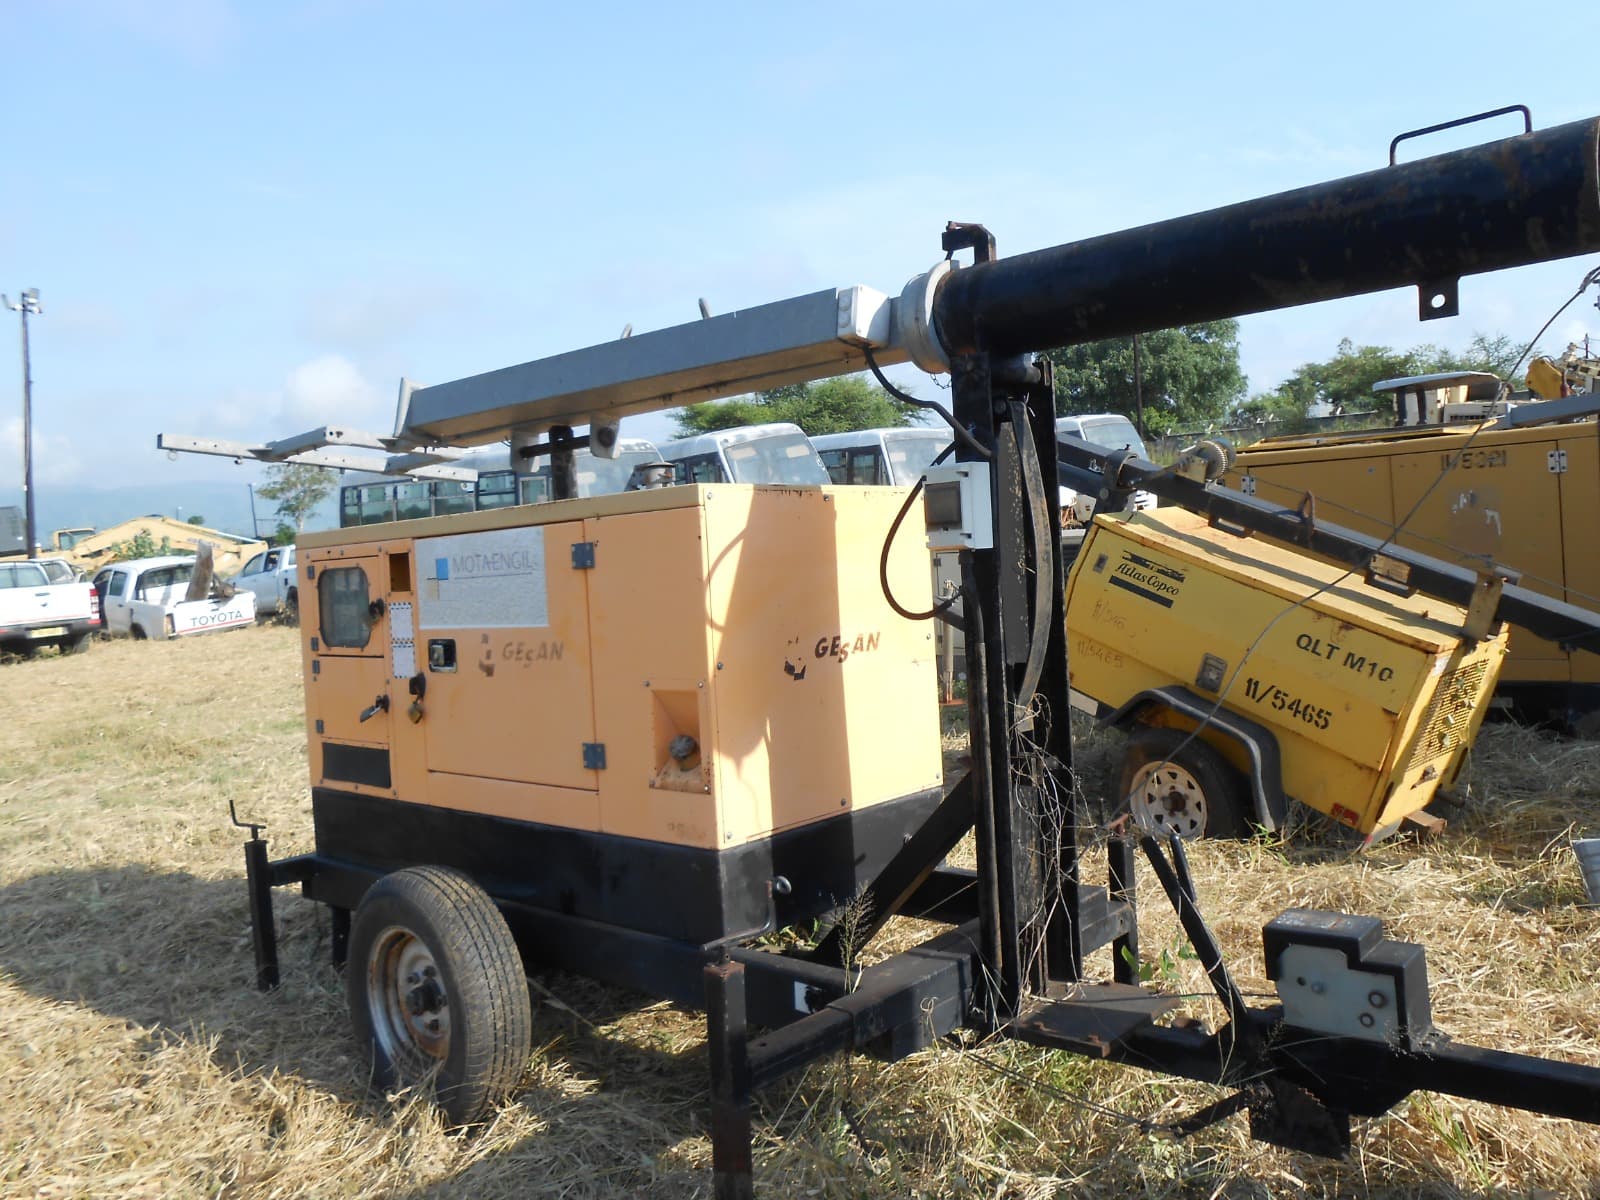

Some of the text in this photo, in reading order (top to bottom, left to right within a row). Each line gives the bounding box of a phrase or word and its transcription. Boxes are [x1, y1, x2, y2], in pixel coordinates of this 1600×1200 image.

[1115, 562, 1179, 596] Atlas Copco
[190, 610, 243, 626] TOYOTA
[815, 631, 881, 663] GESAN
[1296, 633, 1394, 682] QLT M10
[1245, 677, 1332, 730] 11/5465
